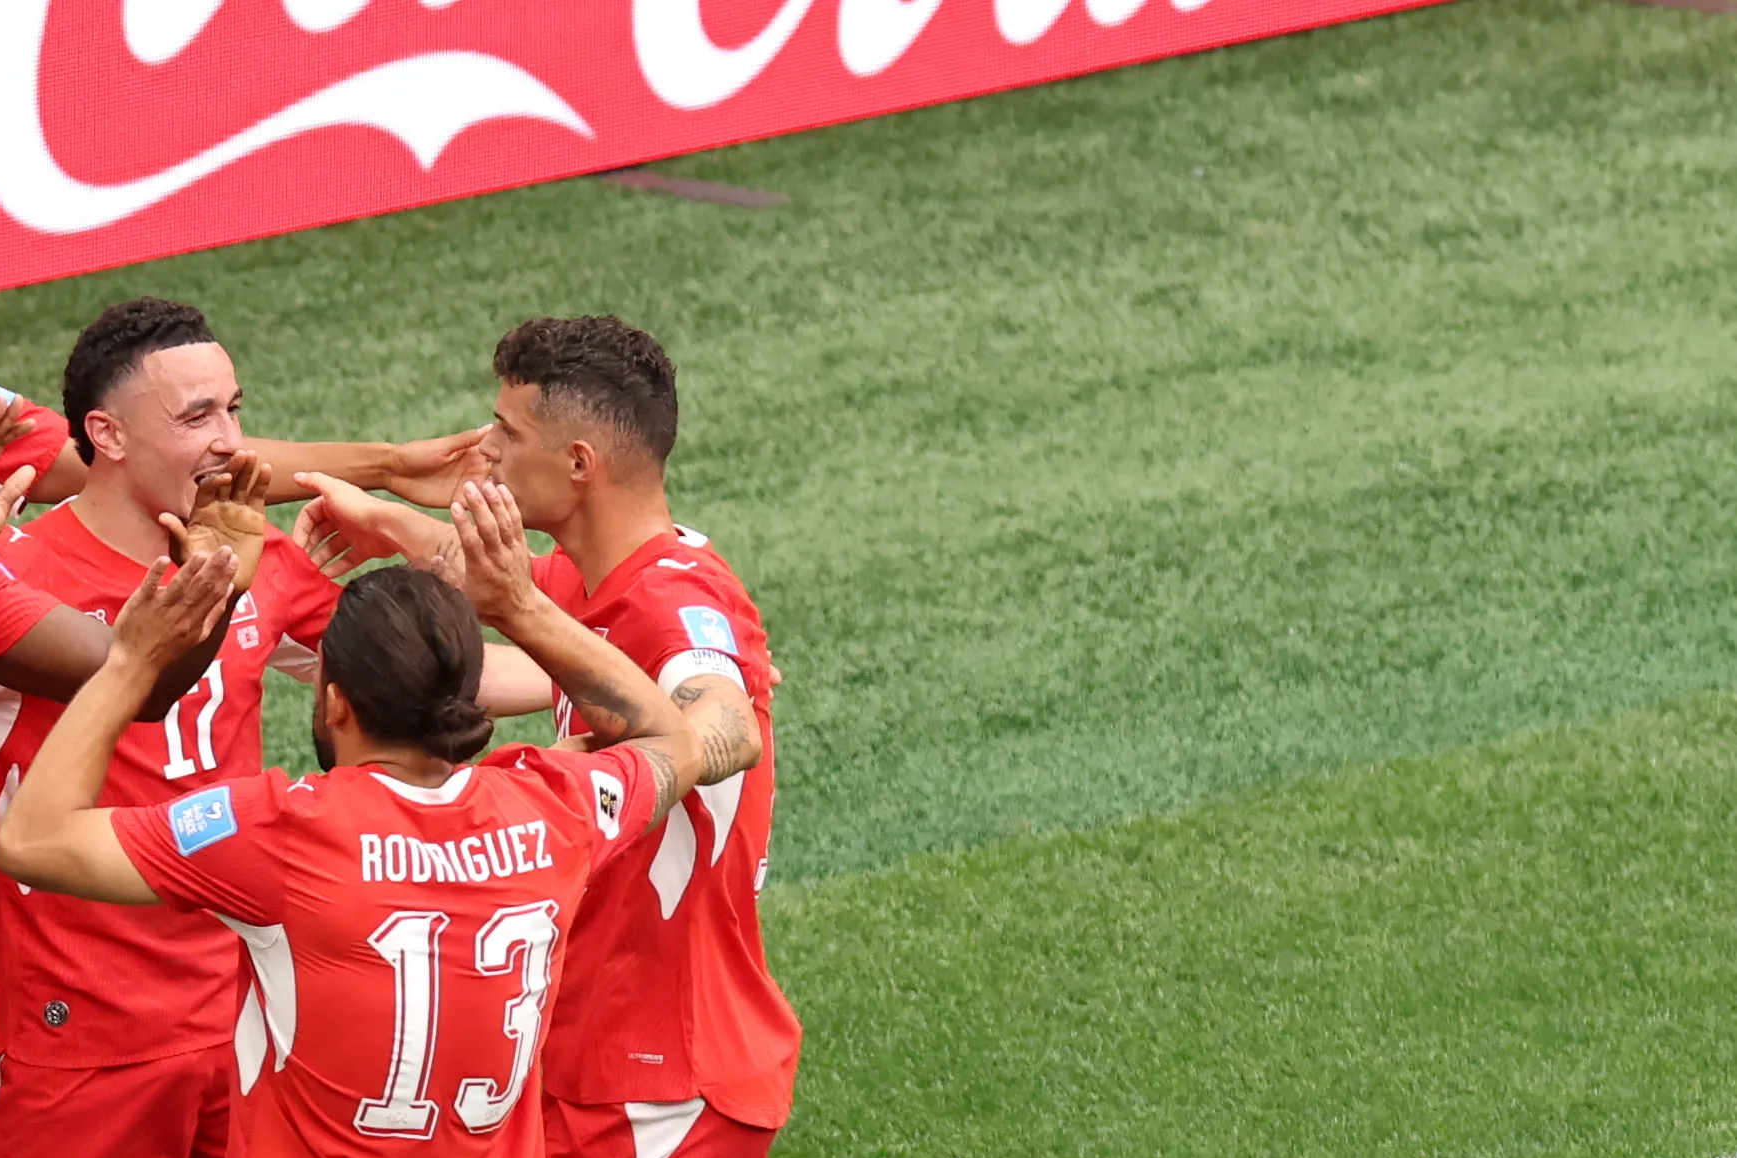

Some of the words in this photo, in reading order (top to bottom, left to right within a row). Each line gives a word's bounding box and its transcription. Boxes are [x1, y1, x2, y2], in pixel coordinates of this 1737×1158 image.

[163, 659, 224, 780] 17
[359, 819, 553, 882] RODRIGUEZ
[353, 899, 560, 1140] 13
